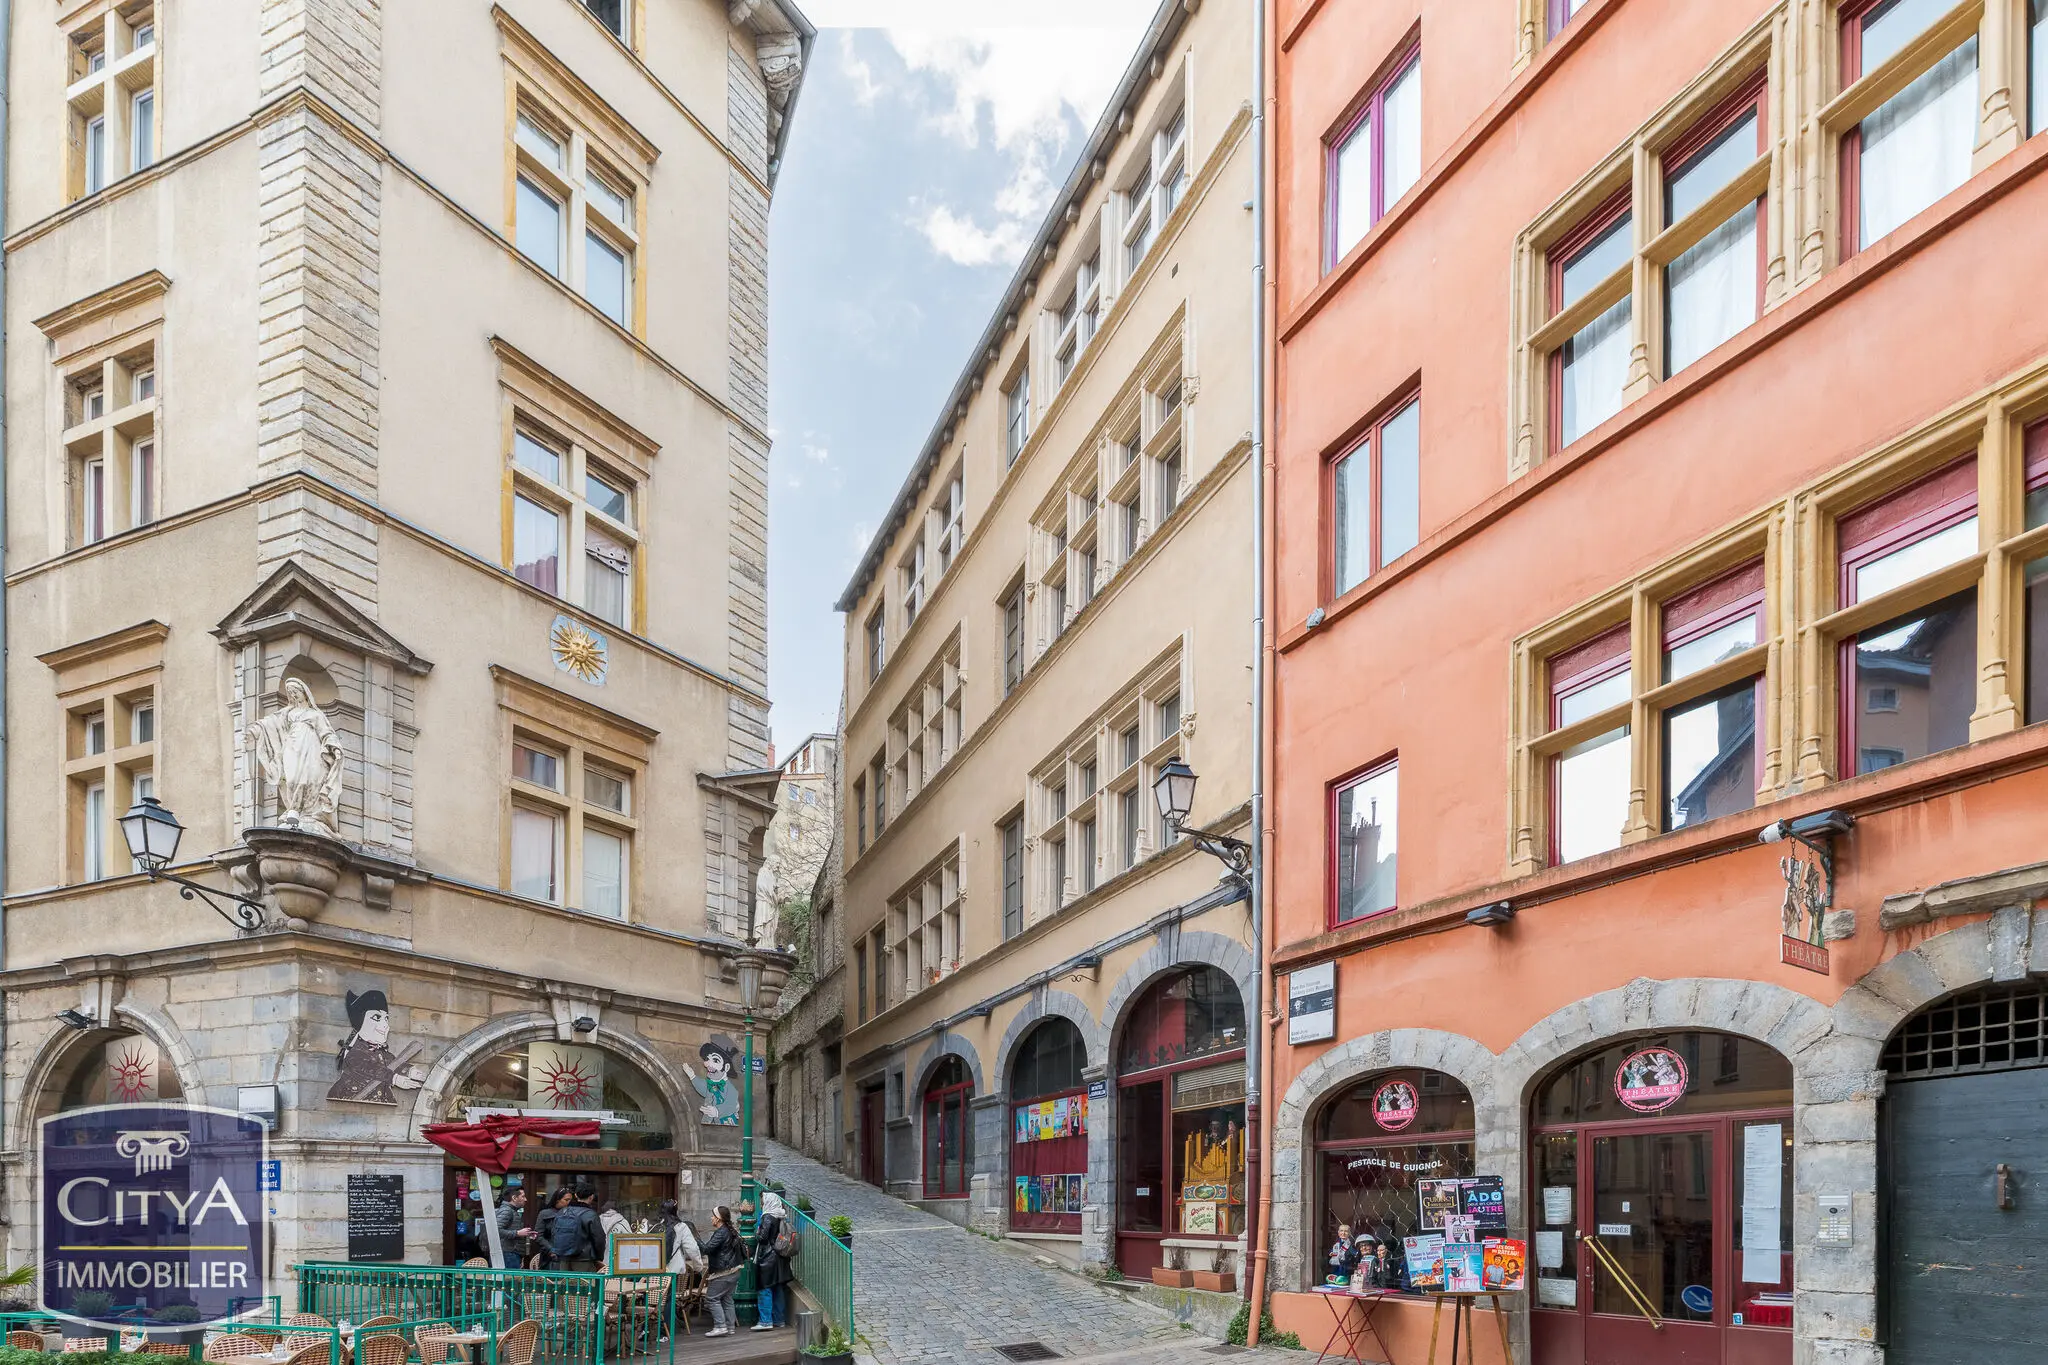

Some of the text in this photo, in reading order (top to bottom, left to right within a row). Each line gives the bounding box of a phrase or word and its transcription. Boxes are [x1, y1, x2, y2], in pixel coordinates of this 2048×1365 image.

[1784, 942, 1828, 968] THÉÂTRE
[514, 1151, 603, 1164] ESTAURANT
[609, 1154, 628, 1166] DU
[1347, 1159, 1443, 1171] PESTACLE DE GUIGNOL
[1601, 1226, 1629, 1234] ENTRÉE
